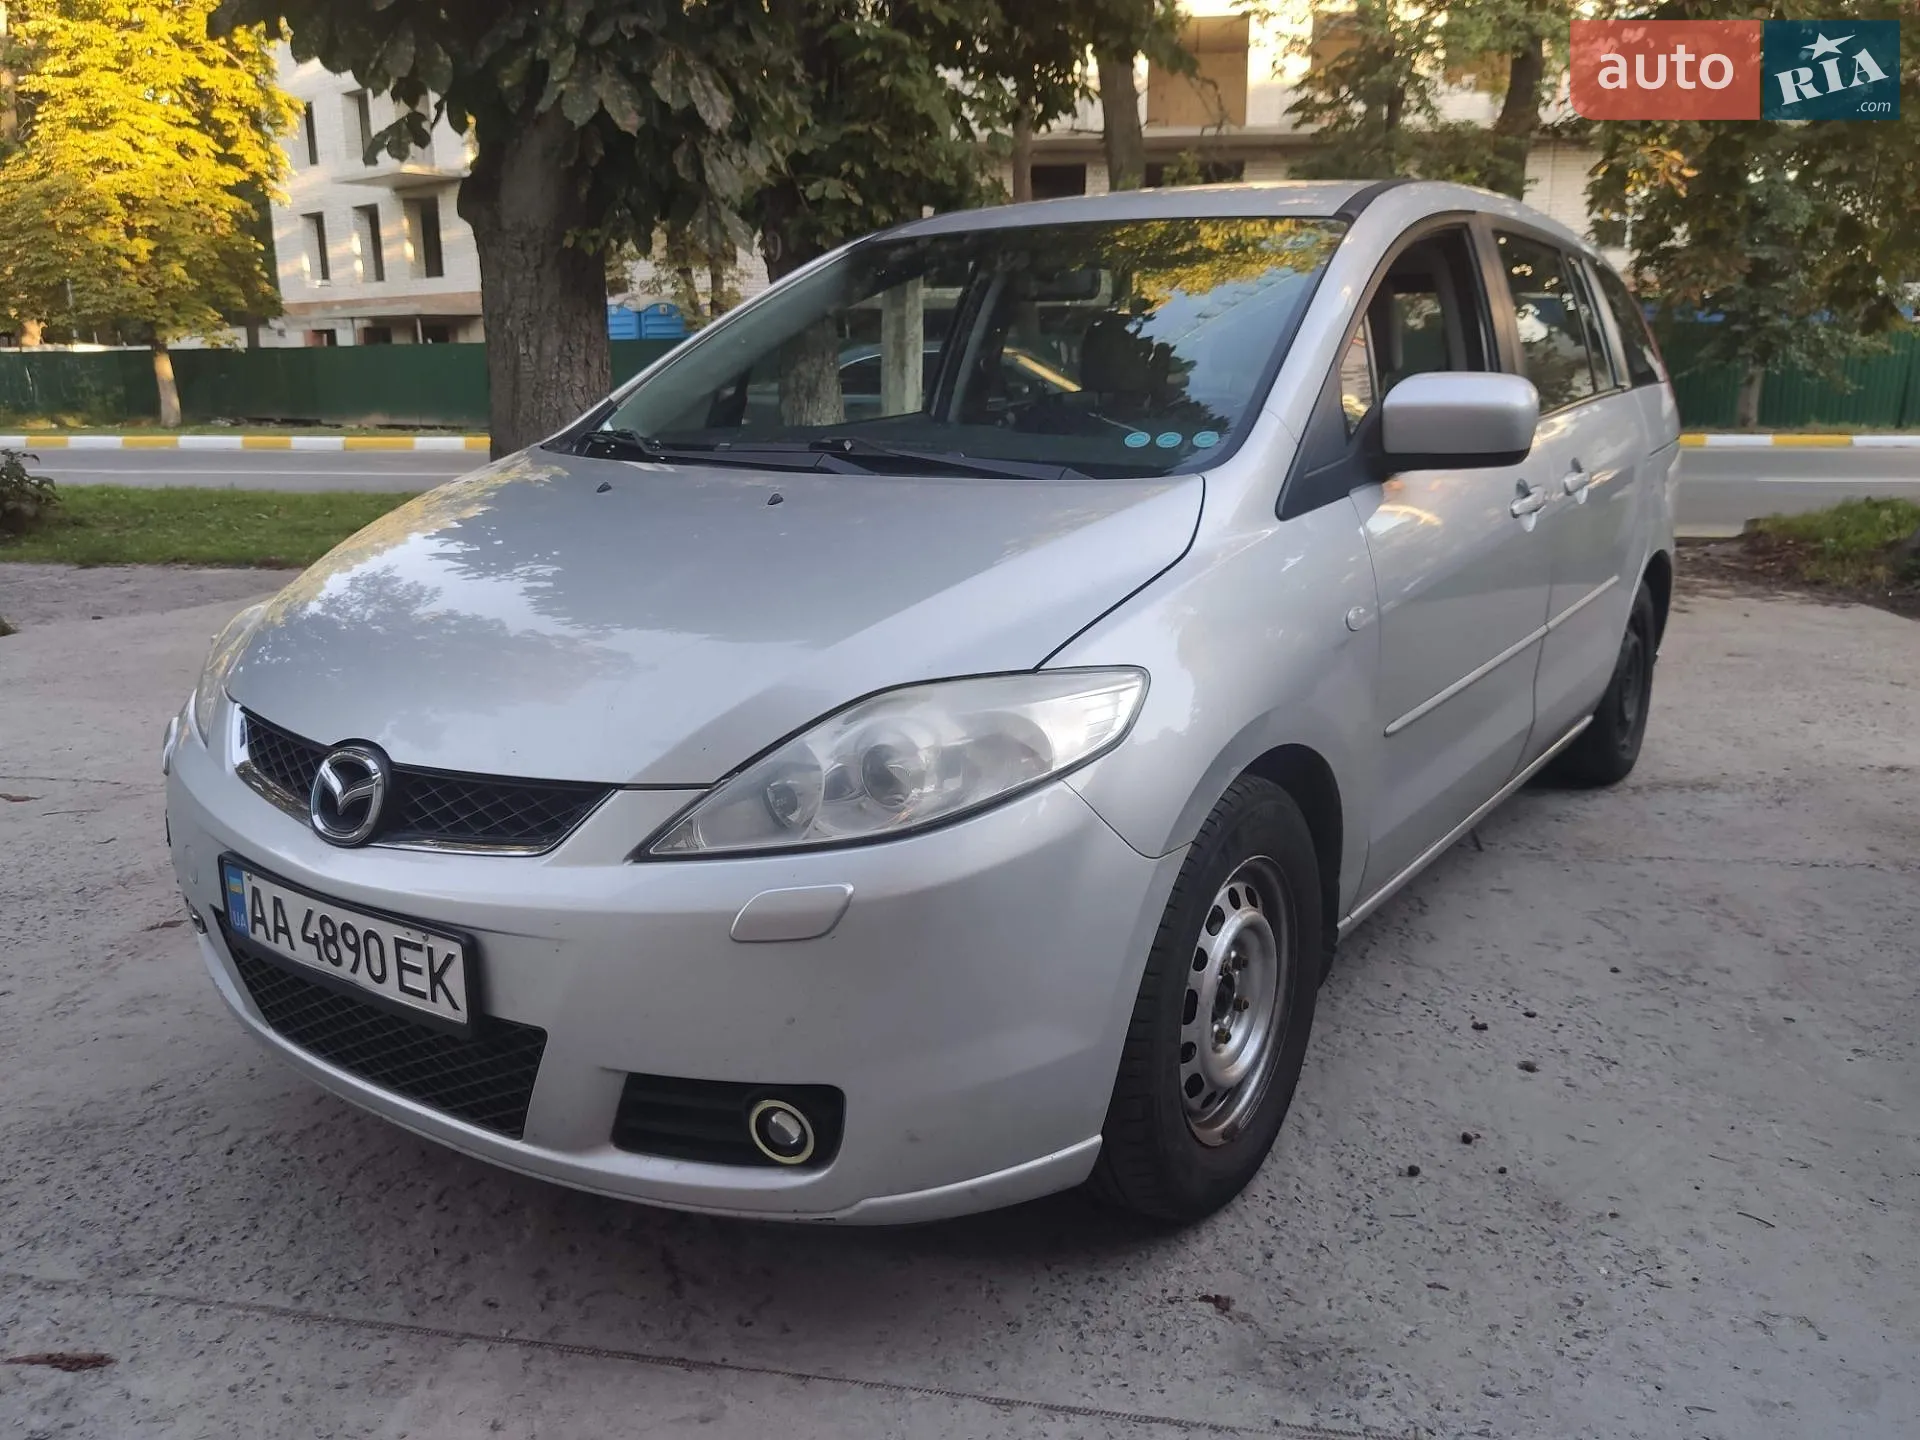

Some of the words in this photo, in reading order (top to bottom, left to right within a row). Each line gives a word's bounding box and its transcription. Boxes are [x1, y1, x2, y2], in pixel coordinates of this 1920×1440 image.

[233, 912, 248, 930] UA
[251, 886, 296, 951] AA
[301, 907, 387, 984] 4890
[394, 935, 461, 1011] EK
